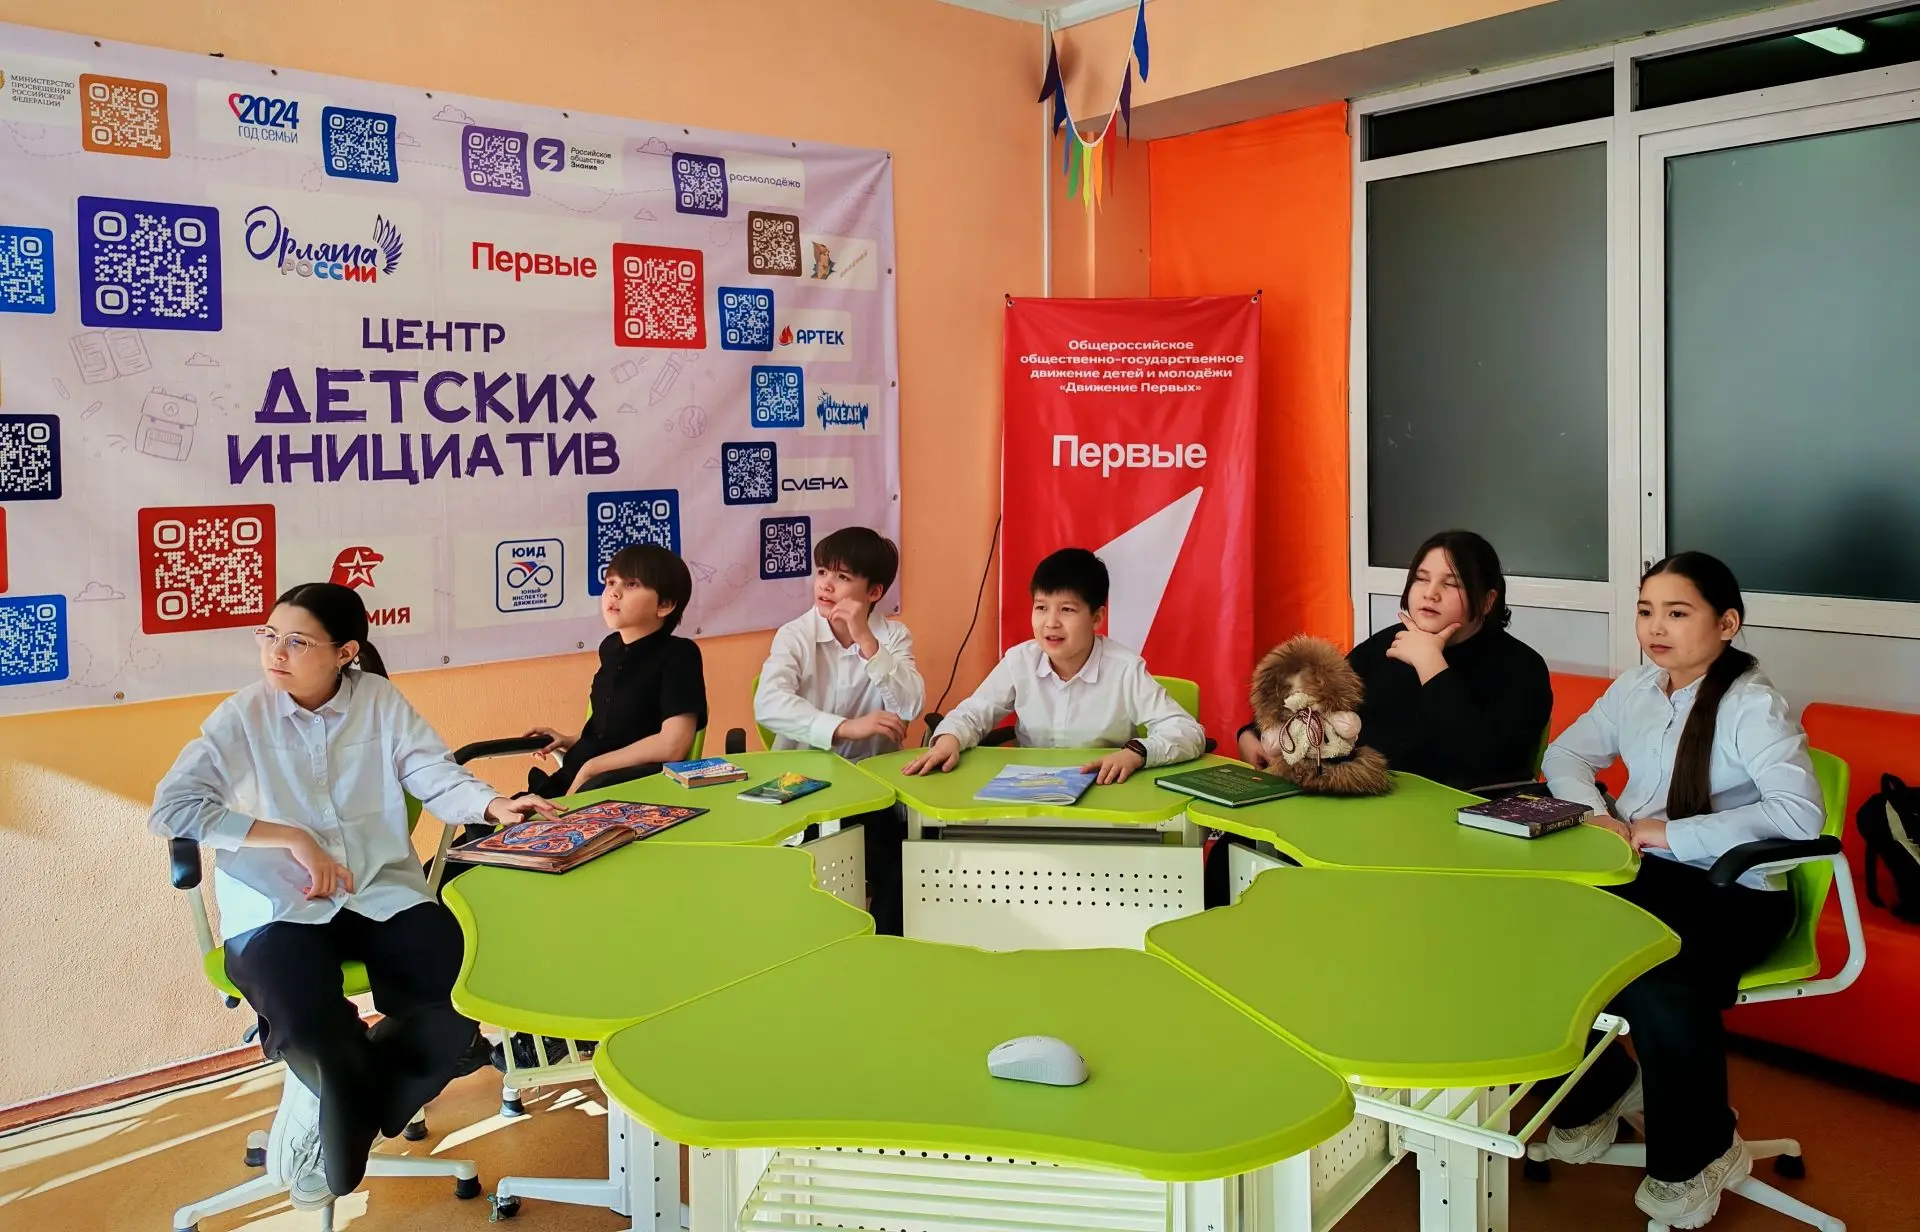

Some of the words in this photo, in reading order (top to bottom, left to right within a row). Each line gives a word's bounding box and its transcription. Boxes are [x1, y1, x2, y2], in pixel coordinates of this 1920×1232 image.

[11, 75, 75, 88] МИНИСТЕРСТВО
[11, 82, 71, 95] ПРОСВЕЩЕНИЯ
[12, 89, 65, 100] РОССИЙСКОЙ
[12, 96, 61, 107] ФЕДЕРАЦИИ
[239, 94, 300, 130] 2024
[570, 147, 612, 159] Российское
[570, 155, 605, 165] общество
[570, 161, 598, 171] Знание
[244, 205, 378, 268] Орлята
[472, 241, 598, 282] Первые
[362, 317, 506, 353] ЦЕНТР
[796, 328, 845, 346] АРТЕК
[1068, 339, 1194, 351] Общероссийское
[1020, 353, 1245, 366] общественно-государственное
[1030, 370, 1100, 379] движение
[1102, 368, 1144, 379] детей
[1146, 370, 1155, 378] и
[1158, 368, 1233, 379] молодёжи
[1060, 381, 1138, 393] «Движение
[1140, 382, 1202, 395] Первых»
[254, 367, 598, 423] ДЕТСКИХ
[825, 407, 861, 421] ОКЕАН
[227, 431, 621, 485] ИНИЦИАТИВ
[1052, 434, 1208, 478] Первые
[781, 476, 849, 492] СМЕНА
[512, 546, 547, 559] ЮИД
[512, 593, 548, 602] ИНСПЕКТОР
[521, 587, 542, 595] ЮНЫЙ
[512, 599, 548, 608] ДВИЖЕНИЯ
